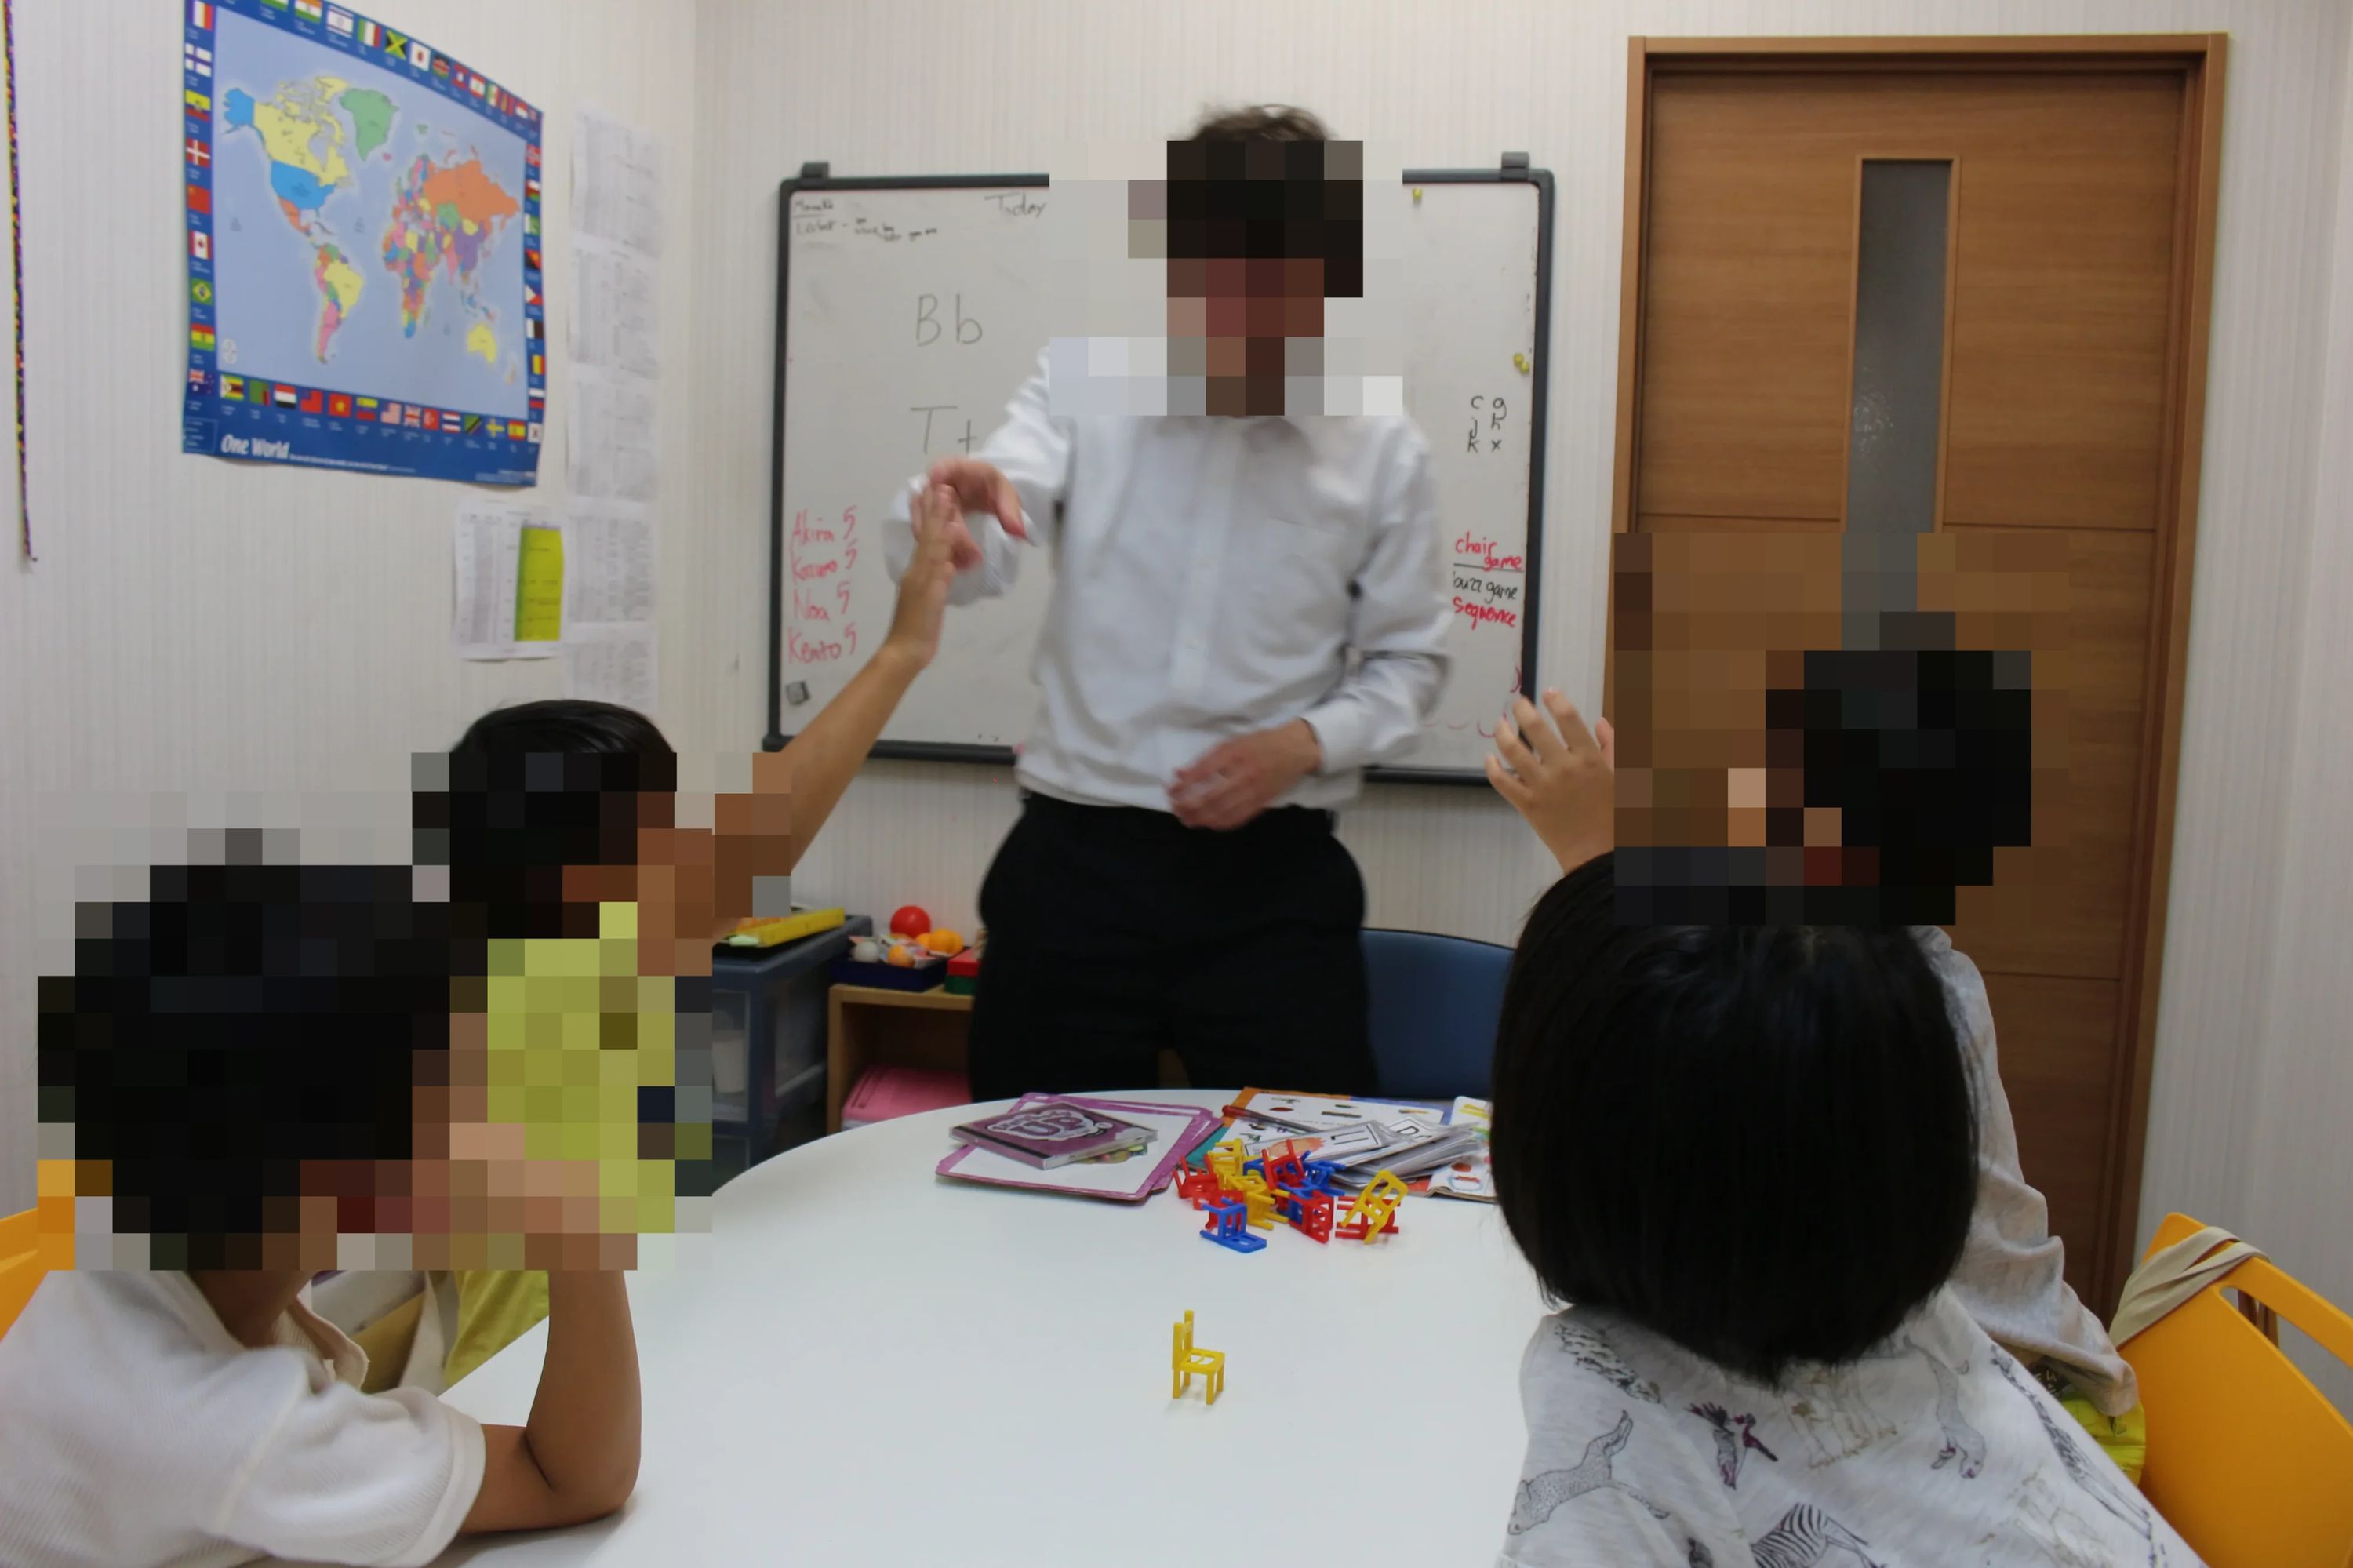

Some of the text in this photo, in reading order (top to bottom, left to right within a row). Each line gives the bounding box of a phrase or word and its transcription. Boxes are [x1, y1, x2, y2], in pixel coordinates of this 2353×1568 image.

[915, 293, 983, 347] Bb
[220, 433, 249, 455] One
[251, 437, 290, 460] World
[791, 508, 835, 546] Akira
[1456, 530, 1497, 556] chair
[1482, 555, 1522, 573] game
[1484, 581, 1518, 604] game
